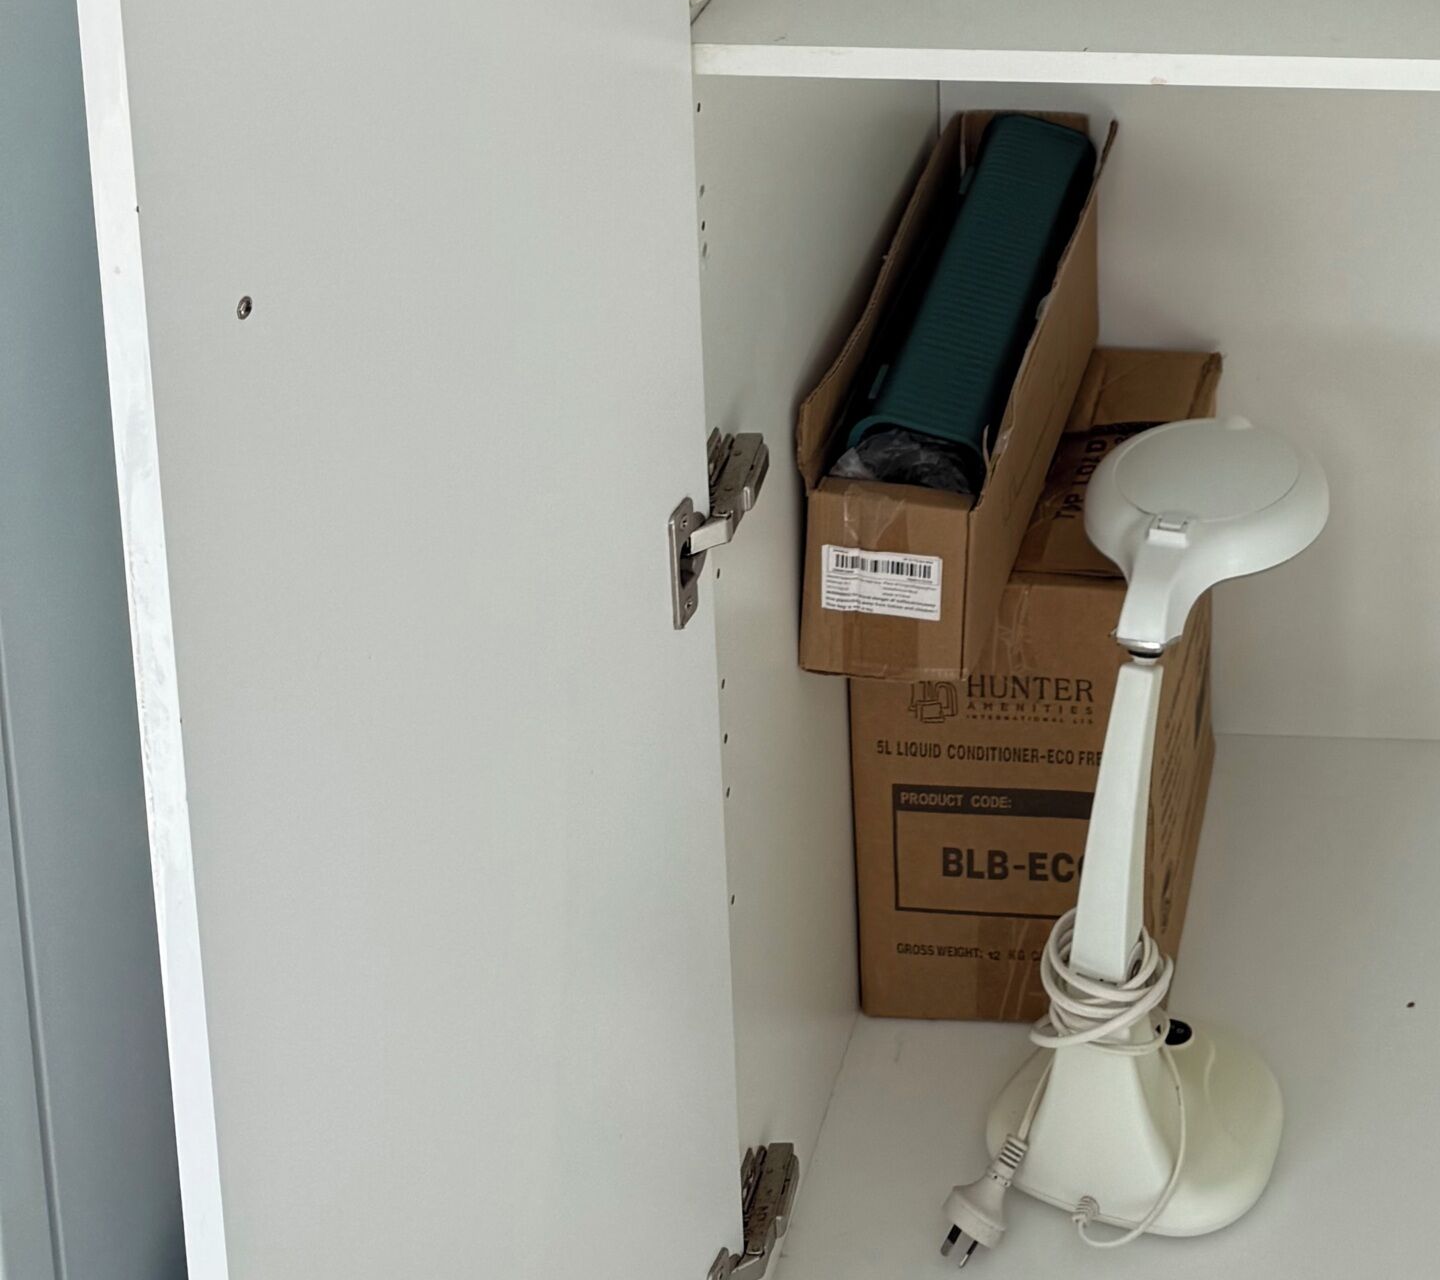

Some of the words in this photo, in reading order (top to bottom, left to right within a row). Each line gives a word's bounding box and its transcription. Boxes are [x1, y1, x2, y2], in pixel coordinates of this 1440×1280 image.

[966, 674, 1094, 703] HUNTER
[966, 701, 1094, 715] AMENITIES
[966, 714, 1065, 724] INTERNATIONAL
[876, 739, 892, 756] 5L
[897, 741, 941, 759] LIQUID
[947, 743, 1075, 765] CONDITIONER-ECO
[1078, 751, 1104, 767] FRE
[900, 791, 963, 807] PRODUCT
[971, 795, 1012, 809] CODE:
[897, 942, 935, 956] GROSS
[937, 946, 983, 959] WEIGHT:
[1008, 950, 1025, 961] KG
